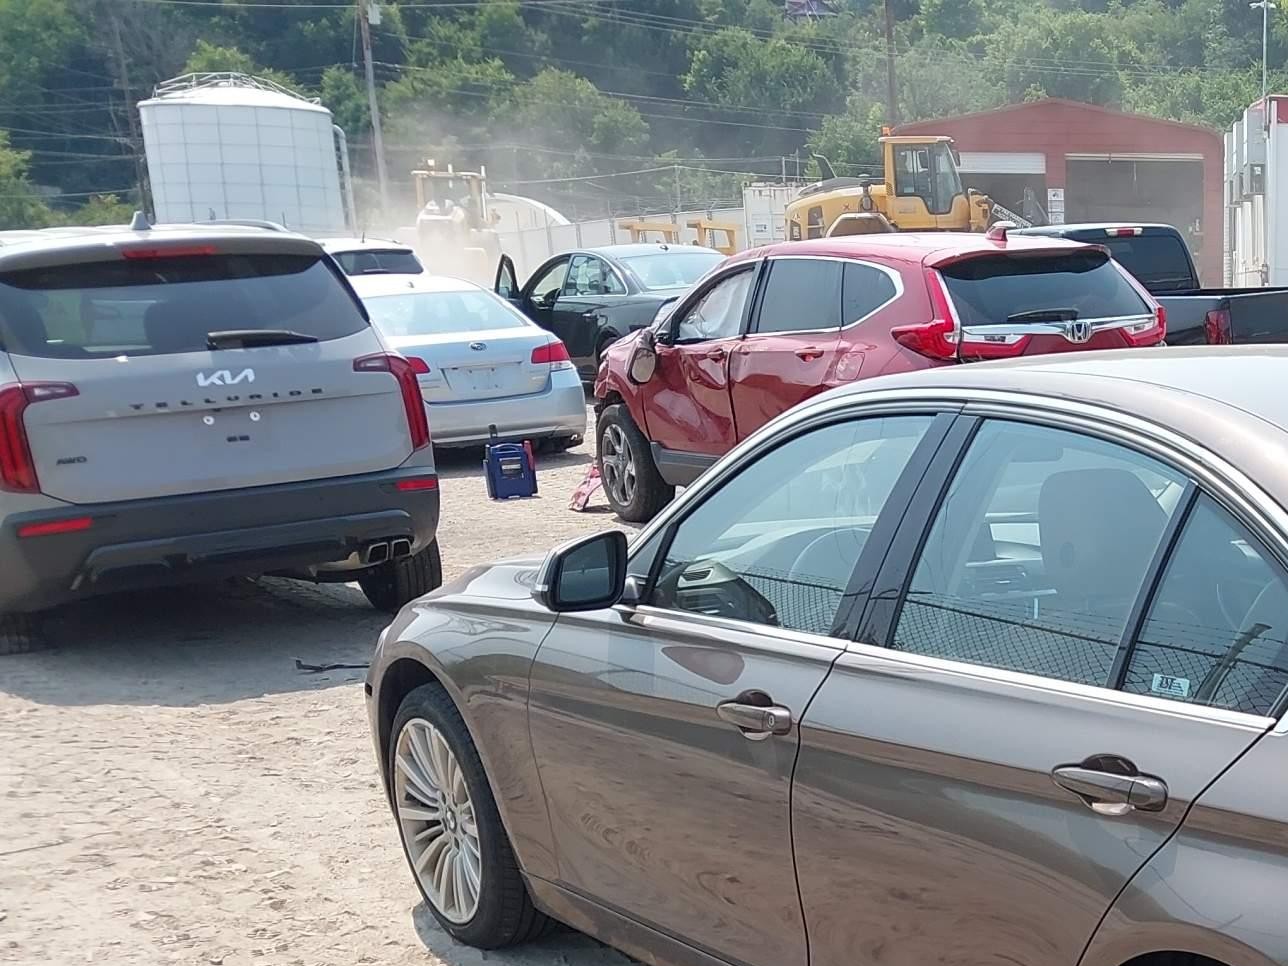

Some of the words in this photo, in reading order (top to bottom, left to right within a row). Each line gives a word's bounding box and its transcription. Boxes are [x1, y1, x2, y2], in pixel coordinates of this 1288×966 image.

[196, 368, 255, 387] KIA
[129, 388, 323, 410] TELLURIDE
[56, 455, 88, 466] AWD
